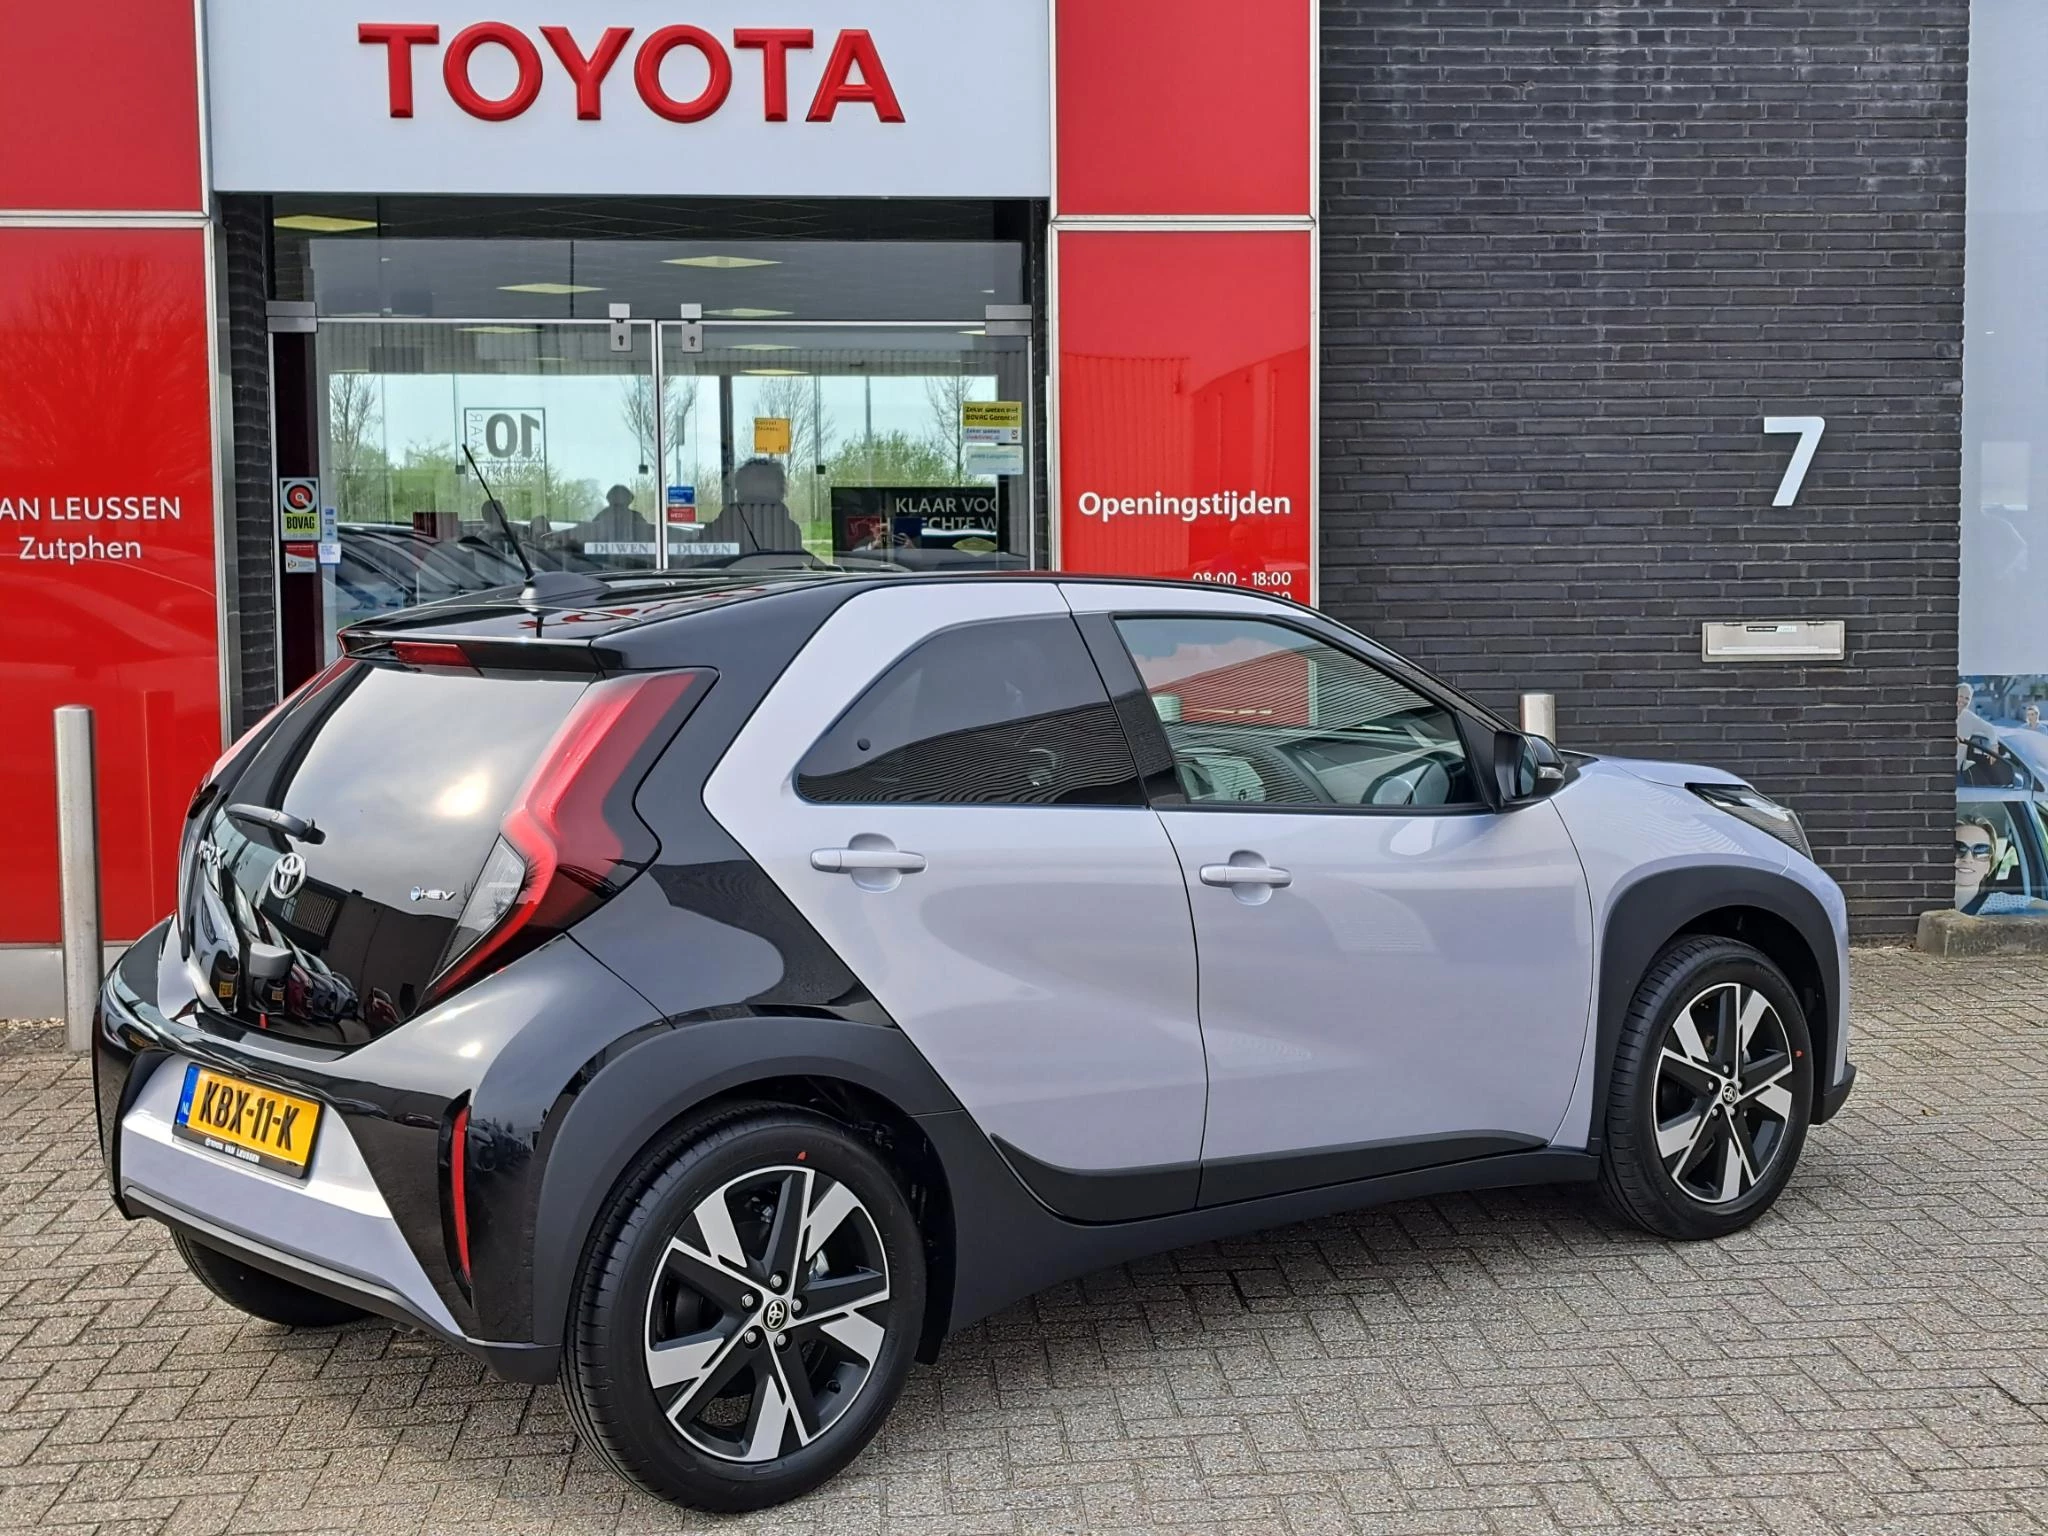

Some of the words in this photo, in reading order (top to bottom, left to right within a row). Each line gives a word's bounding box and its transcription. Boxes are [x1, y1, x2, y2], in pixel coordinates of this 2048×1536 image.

[358, 21, 906, 124] TOYOTA
[1764, 416, 1825, 506] 7
[51, 496, 181, 520] LEUSSEN
[895, 497, 957, 513] KLAAR
[1078, 490, 1291, 522] Openingstijden
[286, 516, 315, 530] BOVAG
[18, 536, 142, 565] Zutphen
[594, 543, 649, 554] DUWEN
[677, 543, 732, 554] DUWEN
[1252, 571, 1292, 586] 18:00
[420, 889, 456, 901] HEV
[181, 1102, 189, 1115] NL
[198, 1081, 300, 1151] KBX-11-K
